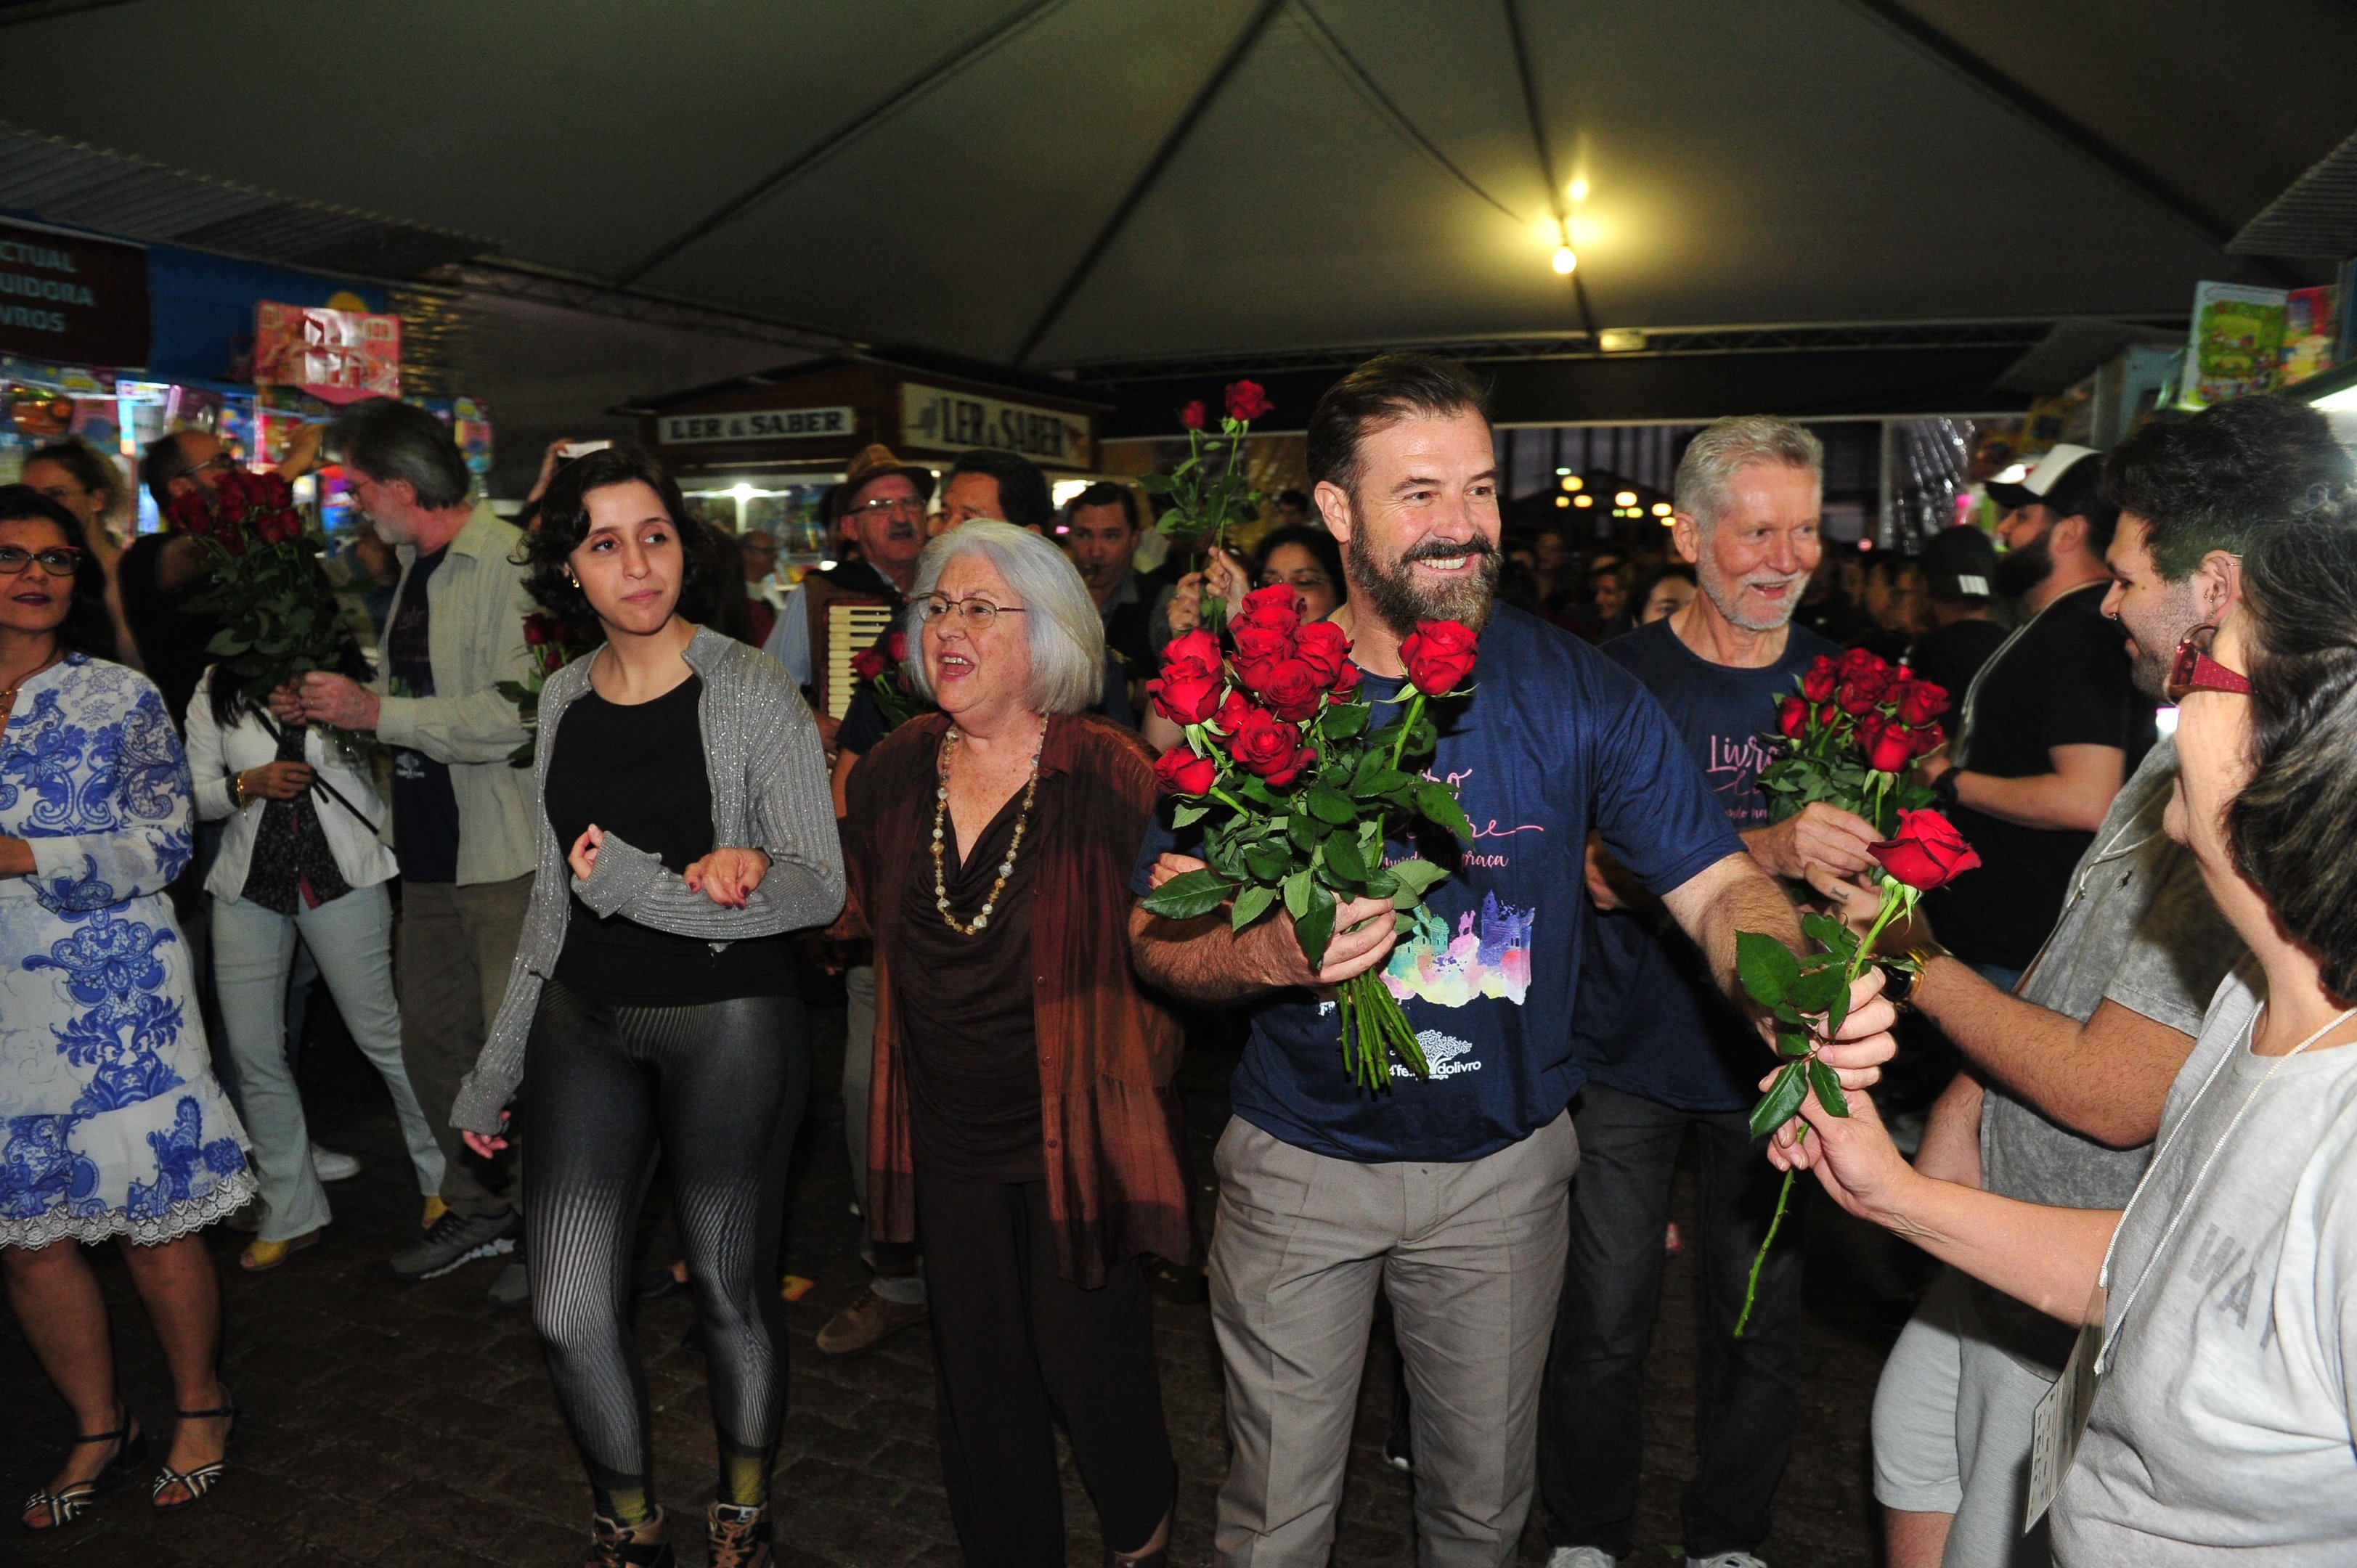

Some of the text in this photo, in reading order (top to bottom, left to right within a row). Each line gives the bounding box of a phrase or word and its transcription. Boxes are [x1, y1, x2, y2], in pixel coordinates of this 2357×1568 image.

[669, 411, 844, 439] LER & SABER
[941, 396, 986, 445] LER
[1001, 409, 1064, 459] SABER
[1461, 849, 1510, 871] praça
[1437, 1061, 1481, 1074] dolivro
